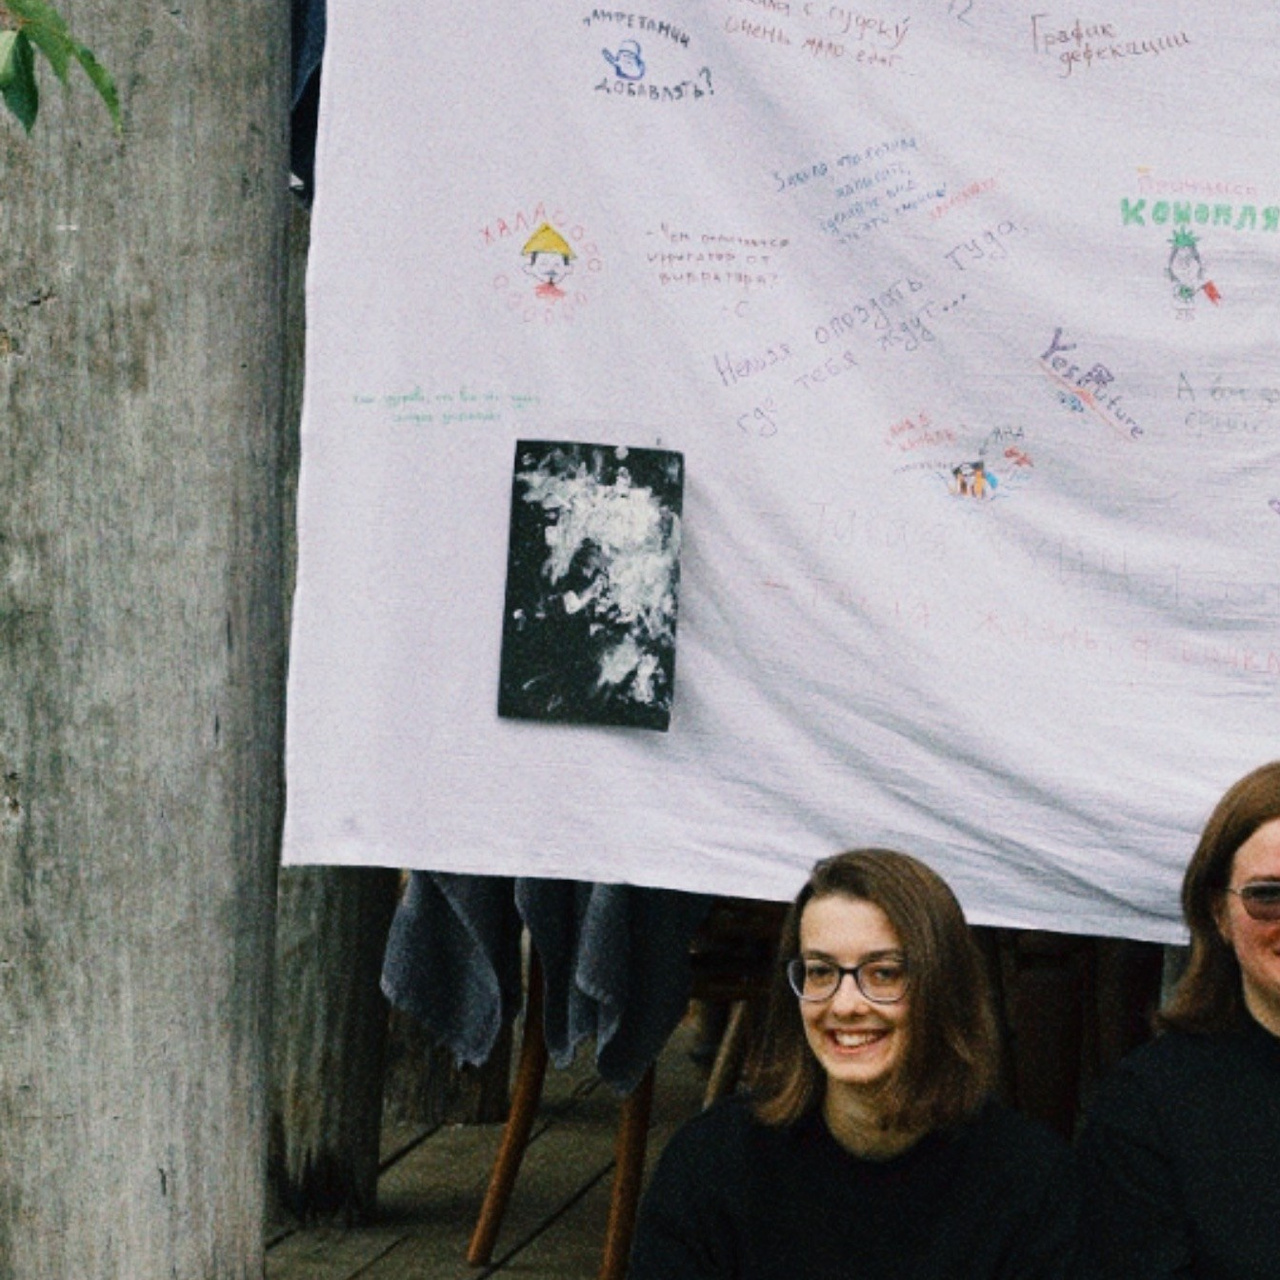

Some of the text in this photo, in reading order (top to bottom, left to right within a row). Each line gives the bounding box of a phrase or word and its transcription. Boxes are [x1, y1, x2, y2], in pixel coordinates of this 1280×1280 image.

[1059, 31, 1192, 79] дефекации
[594, 65, 715, 102] ДОБАВЛЯТЬ?
[793, 349, 860, 390] тебя
[1040, 327, 1080, 379] Yes
